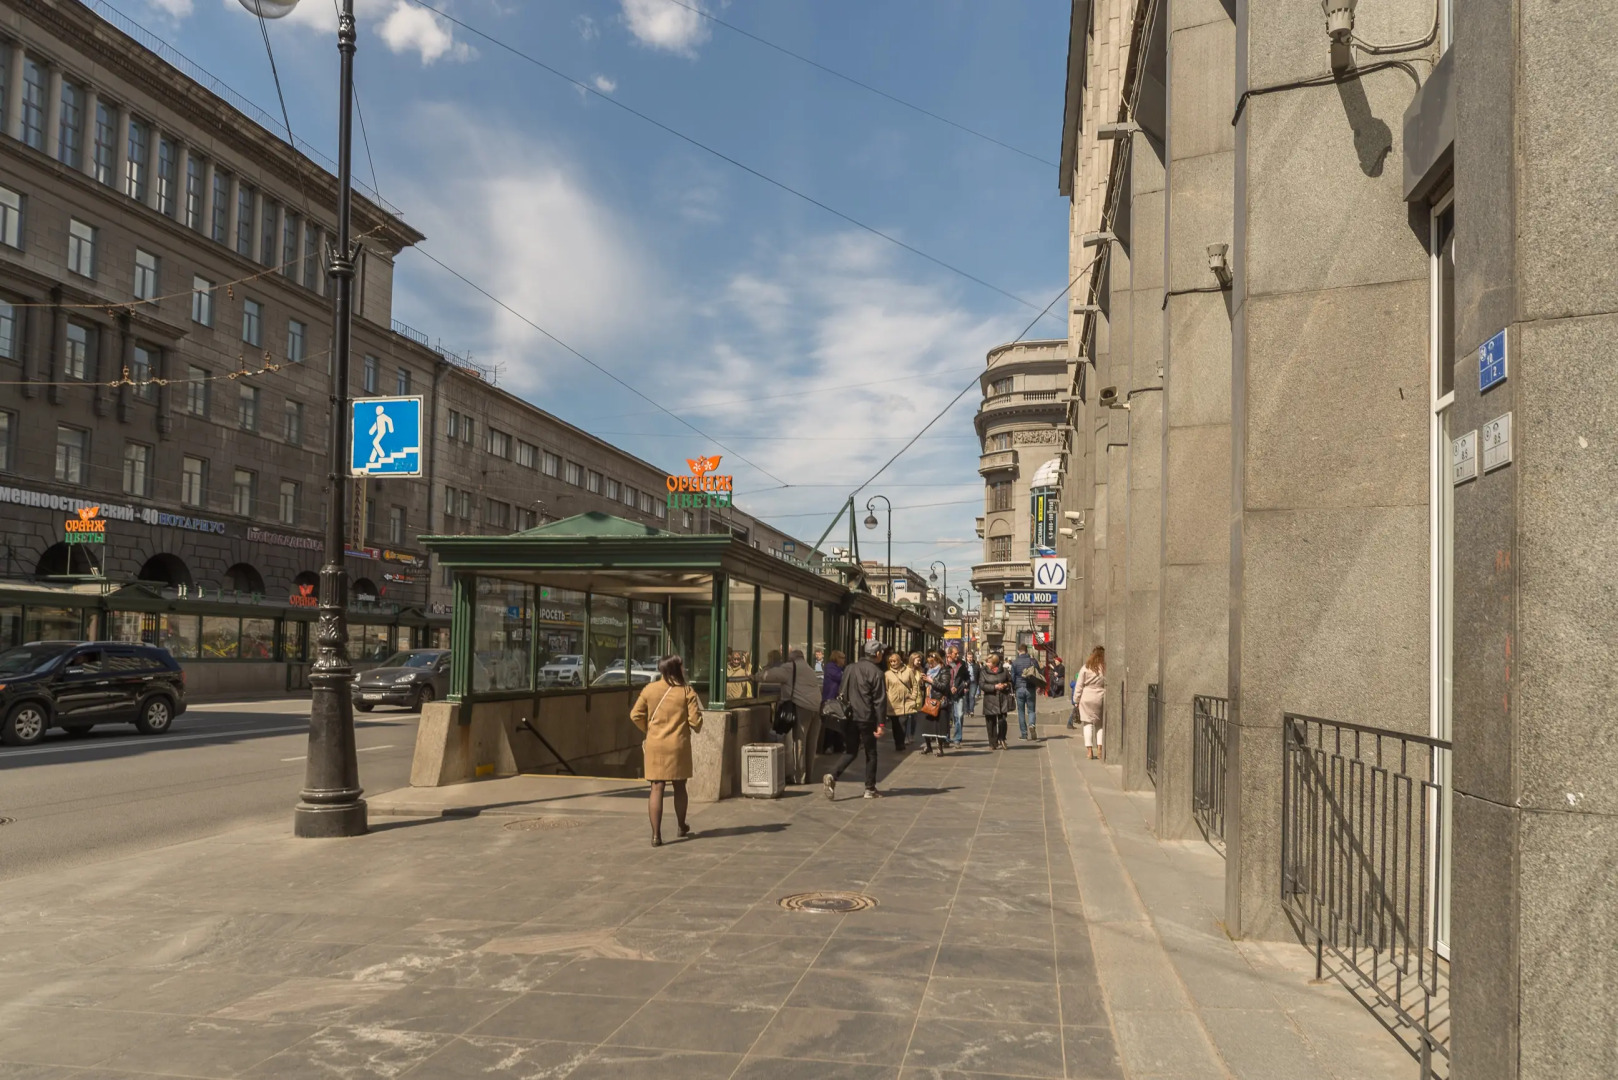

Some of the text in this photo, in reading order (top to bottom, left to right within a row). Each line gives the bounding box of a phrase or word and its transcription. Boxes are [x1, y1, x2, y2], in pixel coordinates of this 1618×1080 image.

[666, 474, 733, 493] ОРАНЖ
[666, 493, 733, 510] ЦВЕТЫ
[65, 519, 105, 532] ОРАНЖ
[158, 512, 225, 534] НОТАРИУС
[65, 532, 105, 545] ЦВЕТЫ
[1012, 592, 1052, 603] DOM MOD
